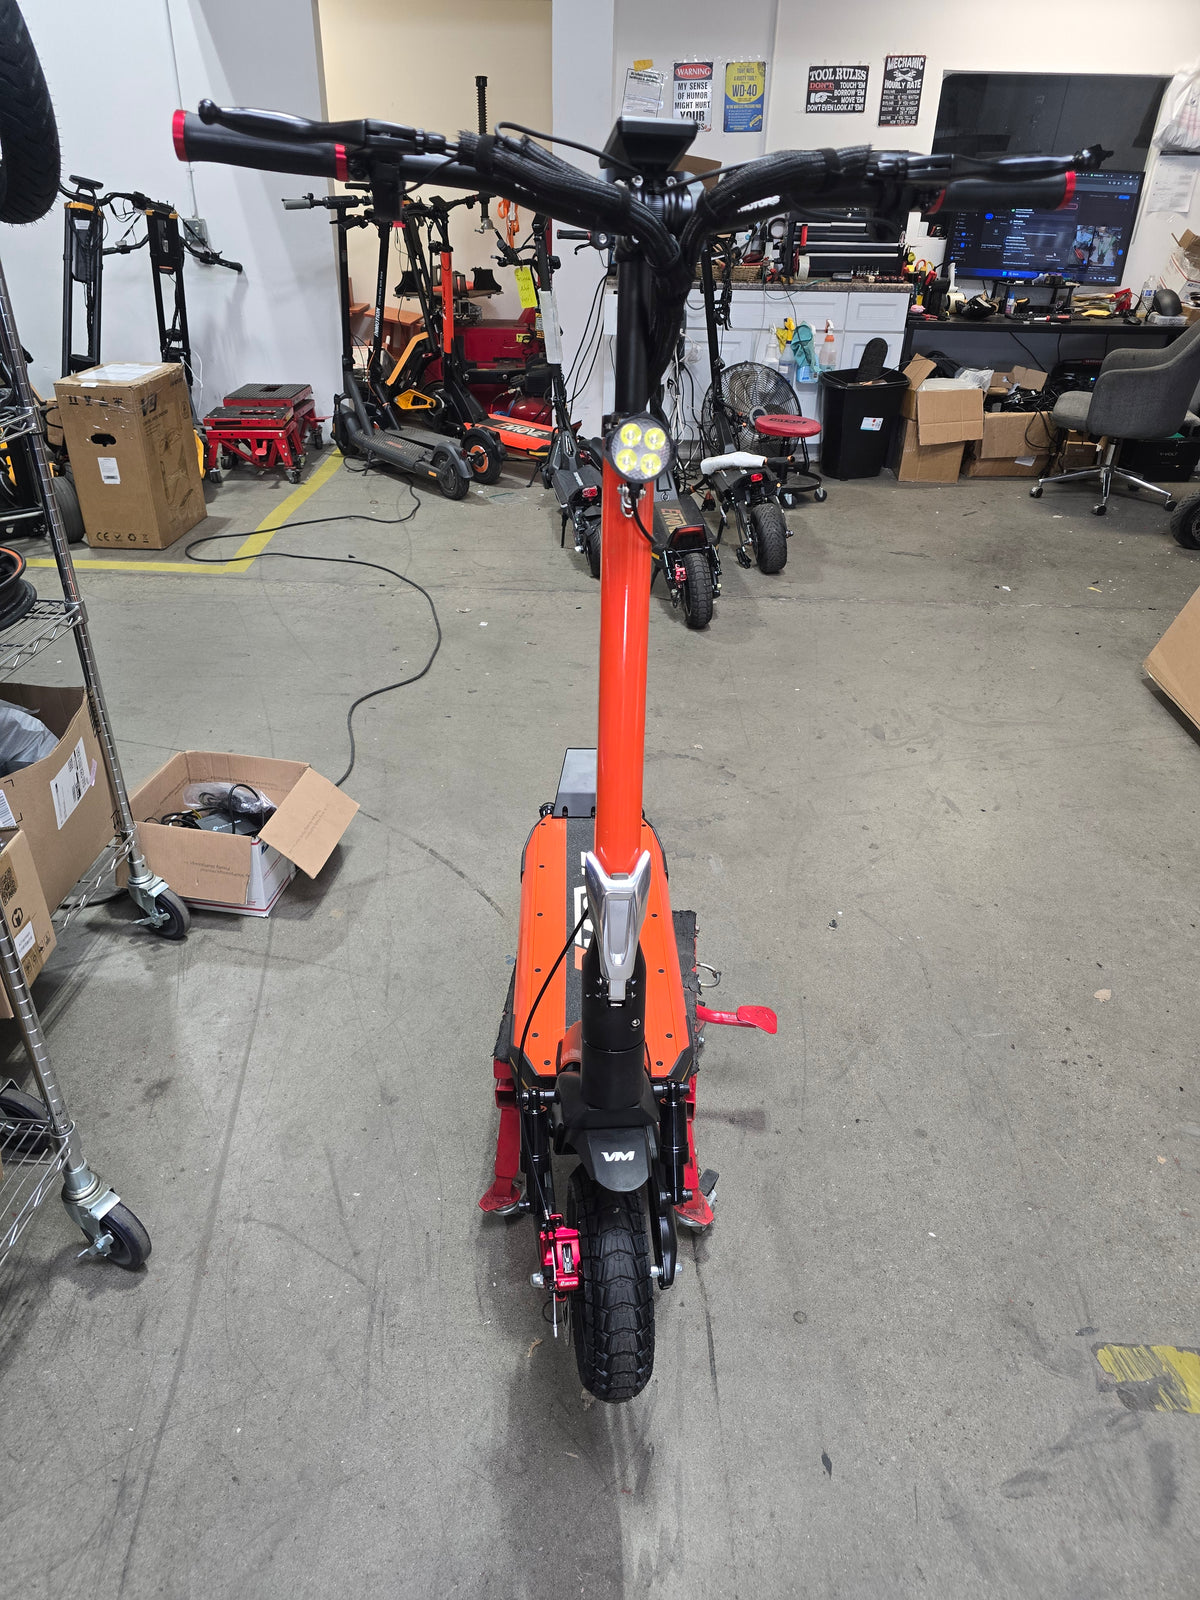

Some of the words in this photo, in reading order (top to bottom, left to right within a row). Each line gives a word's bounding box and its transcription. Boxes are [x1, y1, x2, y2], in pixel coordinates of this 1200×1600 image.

[887, 57, 925, 71] MECHANIC
[676, 68, 711, 76] WARNING
[809, 69, 836, 81] TOOL
[836, 68, 867, 81] RULES
[677, 82, 688, 90] MY
[689, 81, 708, 90] SENSE
[884, 79, 908, 89] HOURLY
[907, 79, 922, 89] RATE
[677, 92, 686, 100] OF
[686, 91, 708, 99] HUMOR
[732, 84, 758, 97] WD-40
[674, 101, 693, 109] MIGHT
[694, 101, 711, 109] HURT
[807, 104, 821, 112] DON'T
[821, 104, 834, 112] EVEN
[834, 103, 848, 111] LOOK
[847, 103, 854, 111] AT
[680, 110, 705, 121] YOUR
[493, 422, 550, 438] EMOVE
[661, 508, 688, 535] EMOV
[600, 1150, 636, 1162] VM
